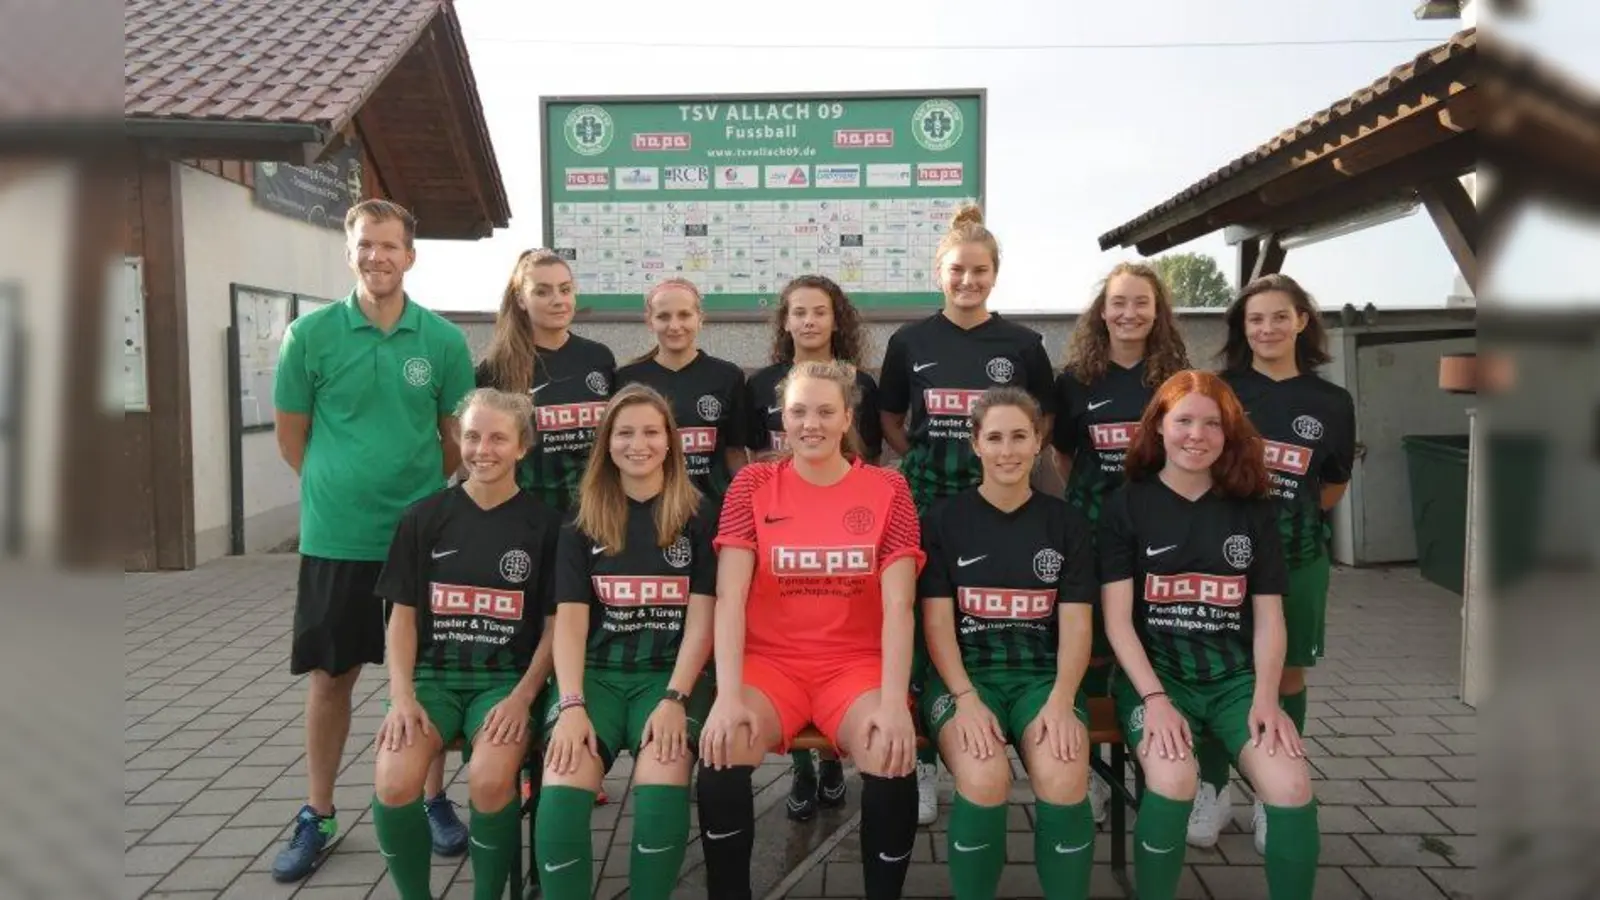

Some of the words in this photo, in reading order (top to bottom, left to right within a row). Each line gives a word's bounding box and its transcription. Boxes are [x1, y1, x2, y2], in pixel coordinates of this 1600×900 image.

[679, 104, 718, 121] TSV
[726, 103, 810, 121] ALLACH
[818, 102, 844, 119] 09
[726, 124, 797, 139] Fussball
[836, 130, 890, 146] hapa
[635, 134, 687, 150] hapa
[707, 146, 817, 157] www.tsvallach09.de
[567, 174, 608, 185] hapa
[672, 167, 708, 182] RCB
[918, 169, 961, 182] hapa
[778, 547, 869, 574] hapa
[597, 577, 684, 605] hapa
[1151, 575, 1243, 602] hapa
[432, 583, 516, 613] hapa
[964, 587, 1050, 618] hapa
[637, 608, 646, 618] &
[650, 607, 682, 618] Türen
[1149, 604, 1195, 616] Fenster
[1196, 606, 1207, 617] &
[470, 619, 479, 629] &
[482, 619, 515, 634] Türen
